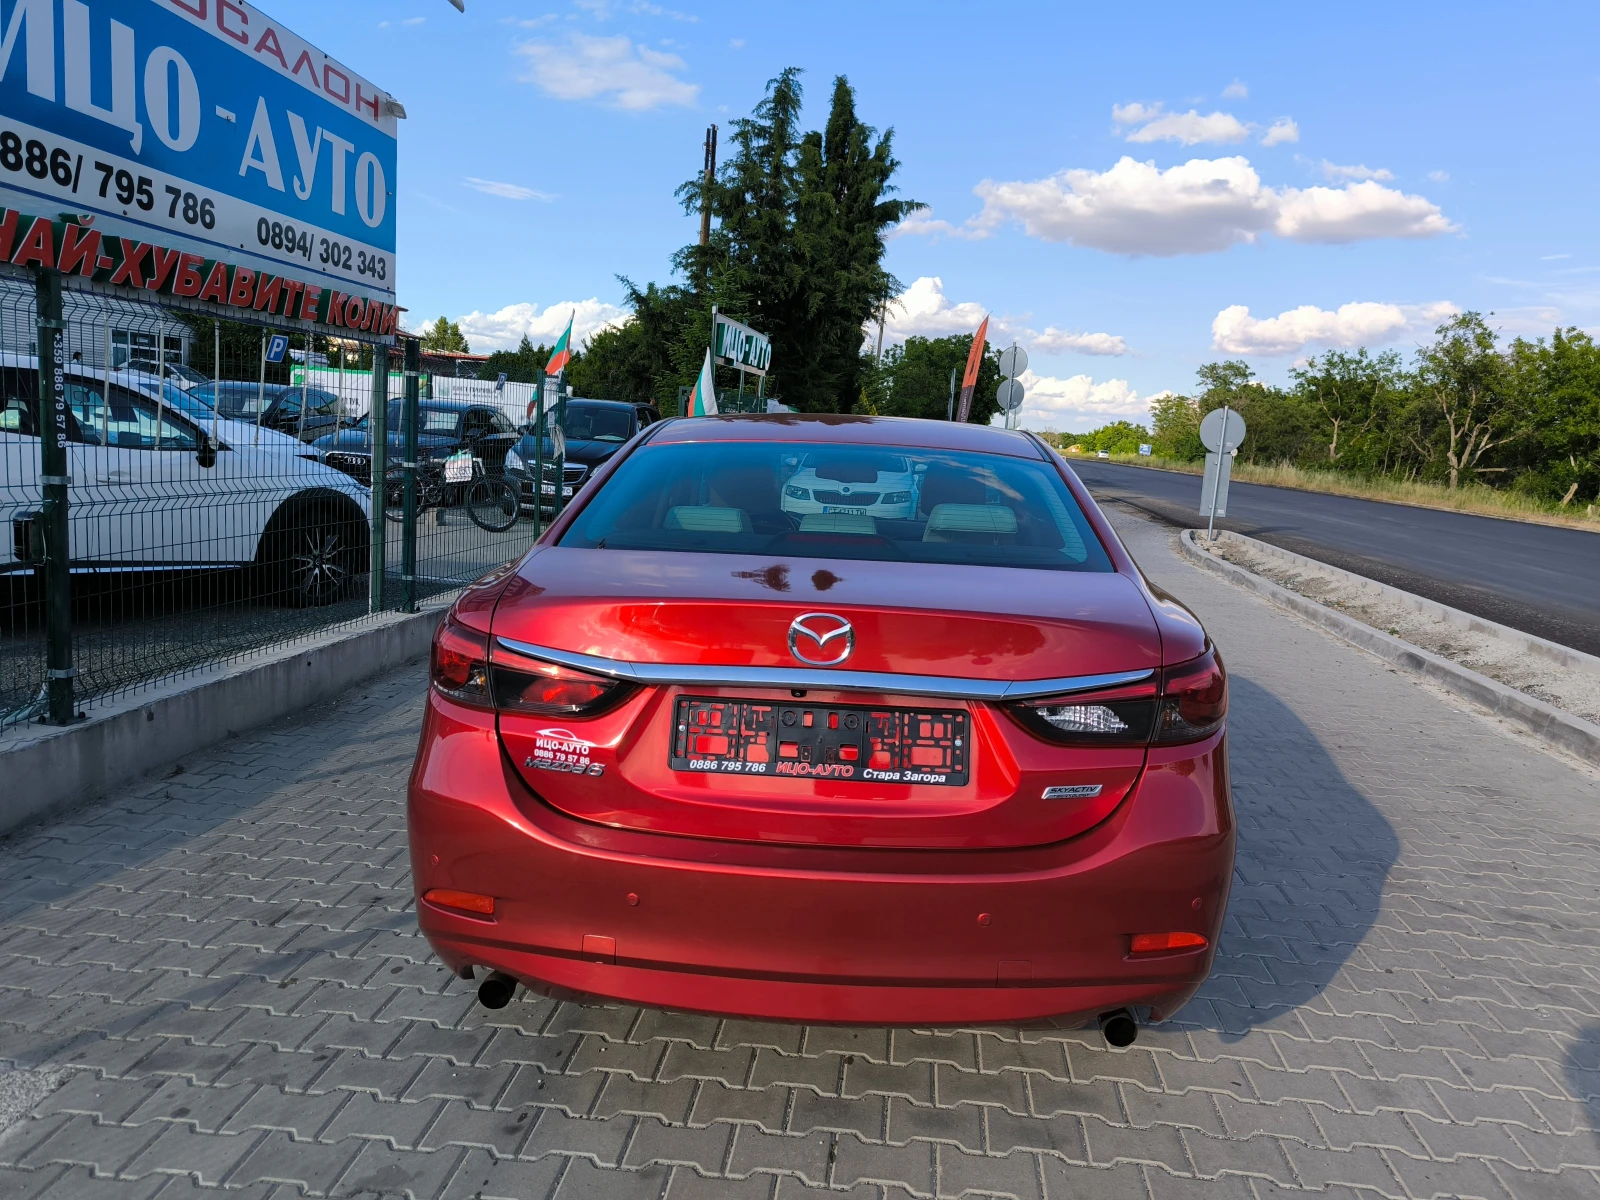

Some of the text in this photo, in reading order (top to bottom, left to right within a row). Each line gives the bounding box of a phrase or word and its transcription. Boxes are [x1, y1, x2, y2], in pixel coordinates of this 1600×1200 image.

[95, 160, 154, 211] 795
[165, 184, 216, 230] 786
[256, 216, 315, 262] 0894/
[319, 237, 353, 271] 302
[357, 250, 386, 281] 343
[325, 288, 400, 336] КОЛИ
[269, 338, 284, 359] P
[721, 323, 772, 371] ИЦО-АУТО
[53, 332, 67, 448] +359 886 79 57 86
[533, 748, 590, 765] 0886 79 57 86
[535, 738, 589, 755] ИЦО-АУТО
[689, 759, 946, 783] 0886 795 786 ИЦО-АУТО Стара Загора
